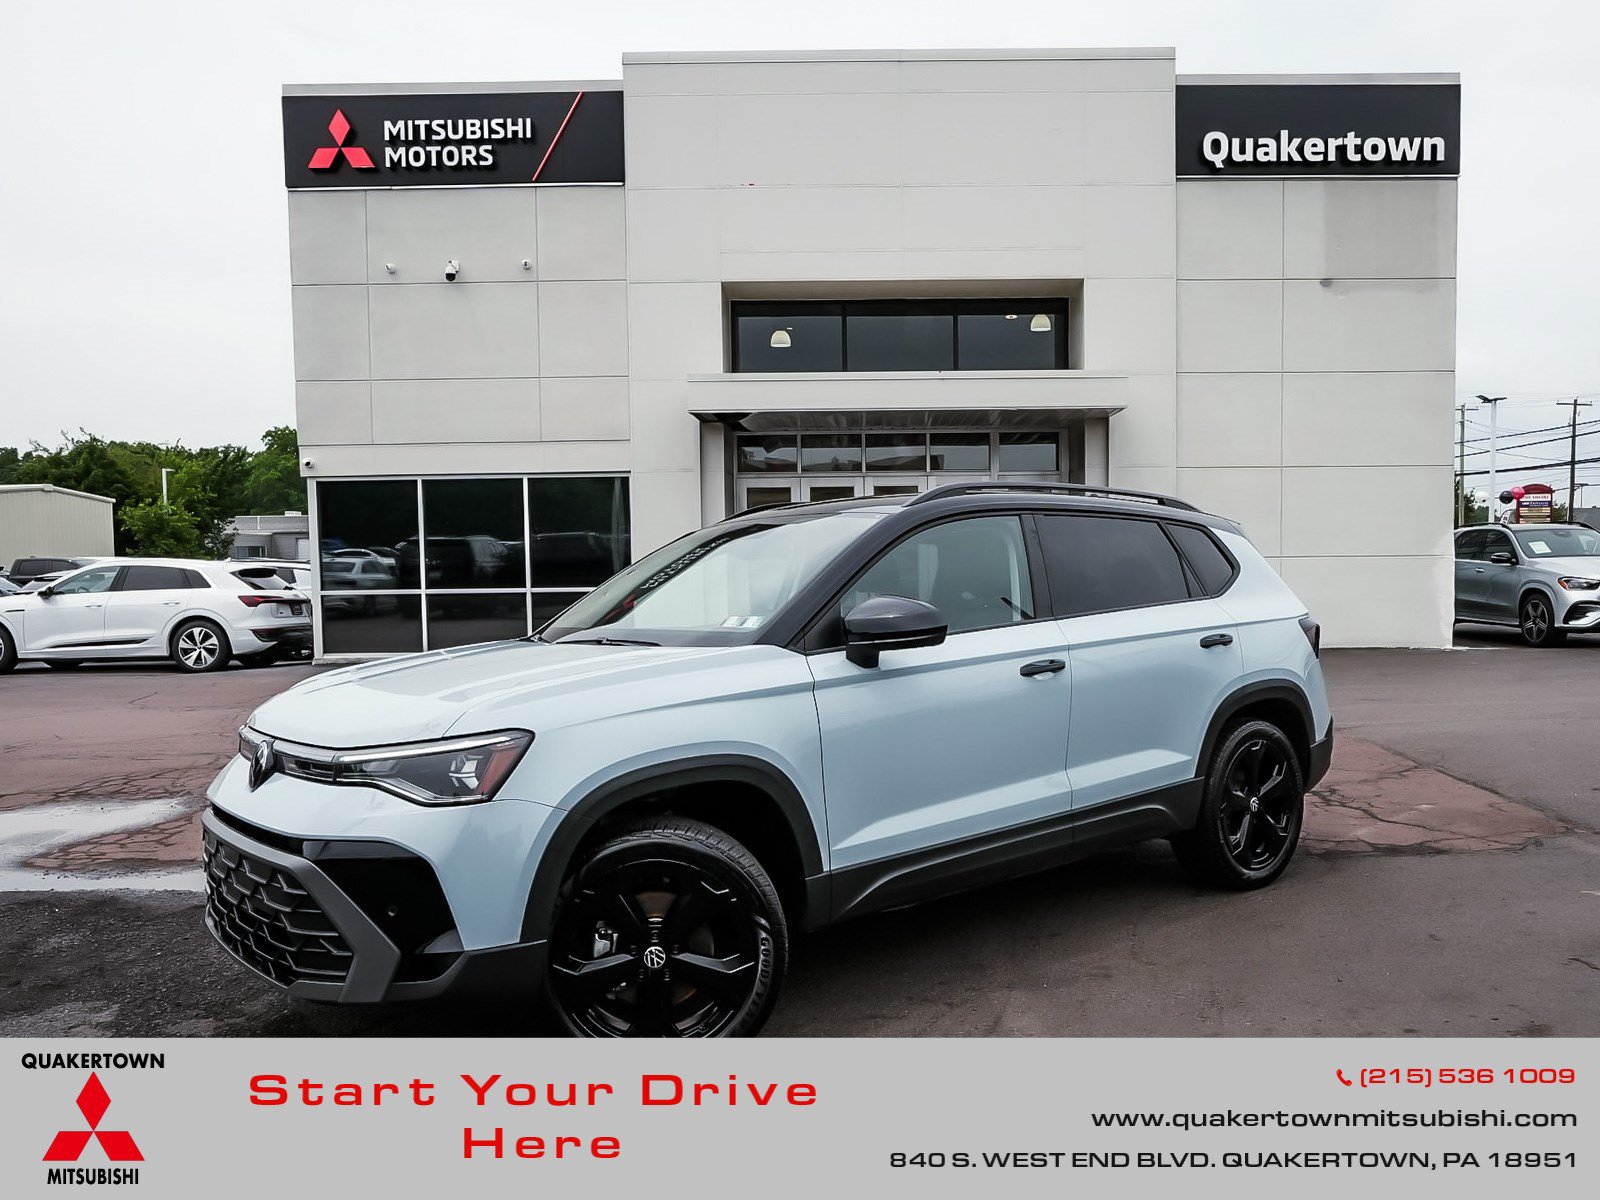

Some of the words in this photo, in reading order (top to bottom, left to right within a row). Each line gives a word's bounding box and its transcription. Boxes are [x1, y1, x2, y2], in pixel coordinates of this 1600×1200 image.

[383, 117, 532, 141] MITSUBISHI
[384, 144, 494, 168] MOTORS
[1202, 129, 1446, 169] Quakertown
